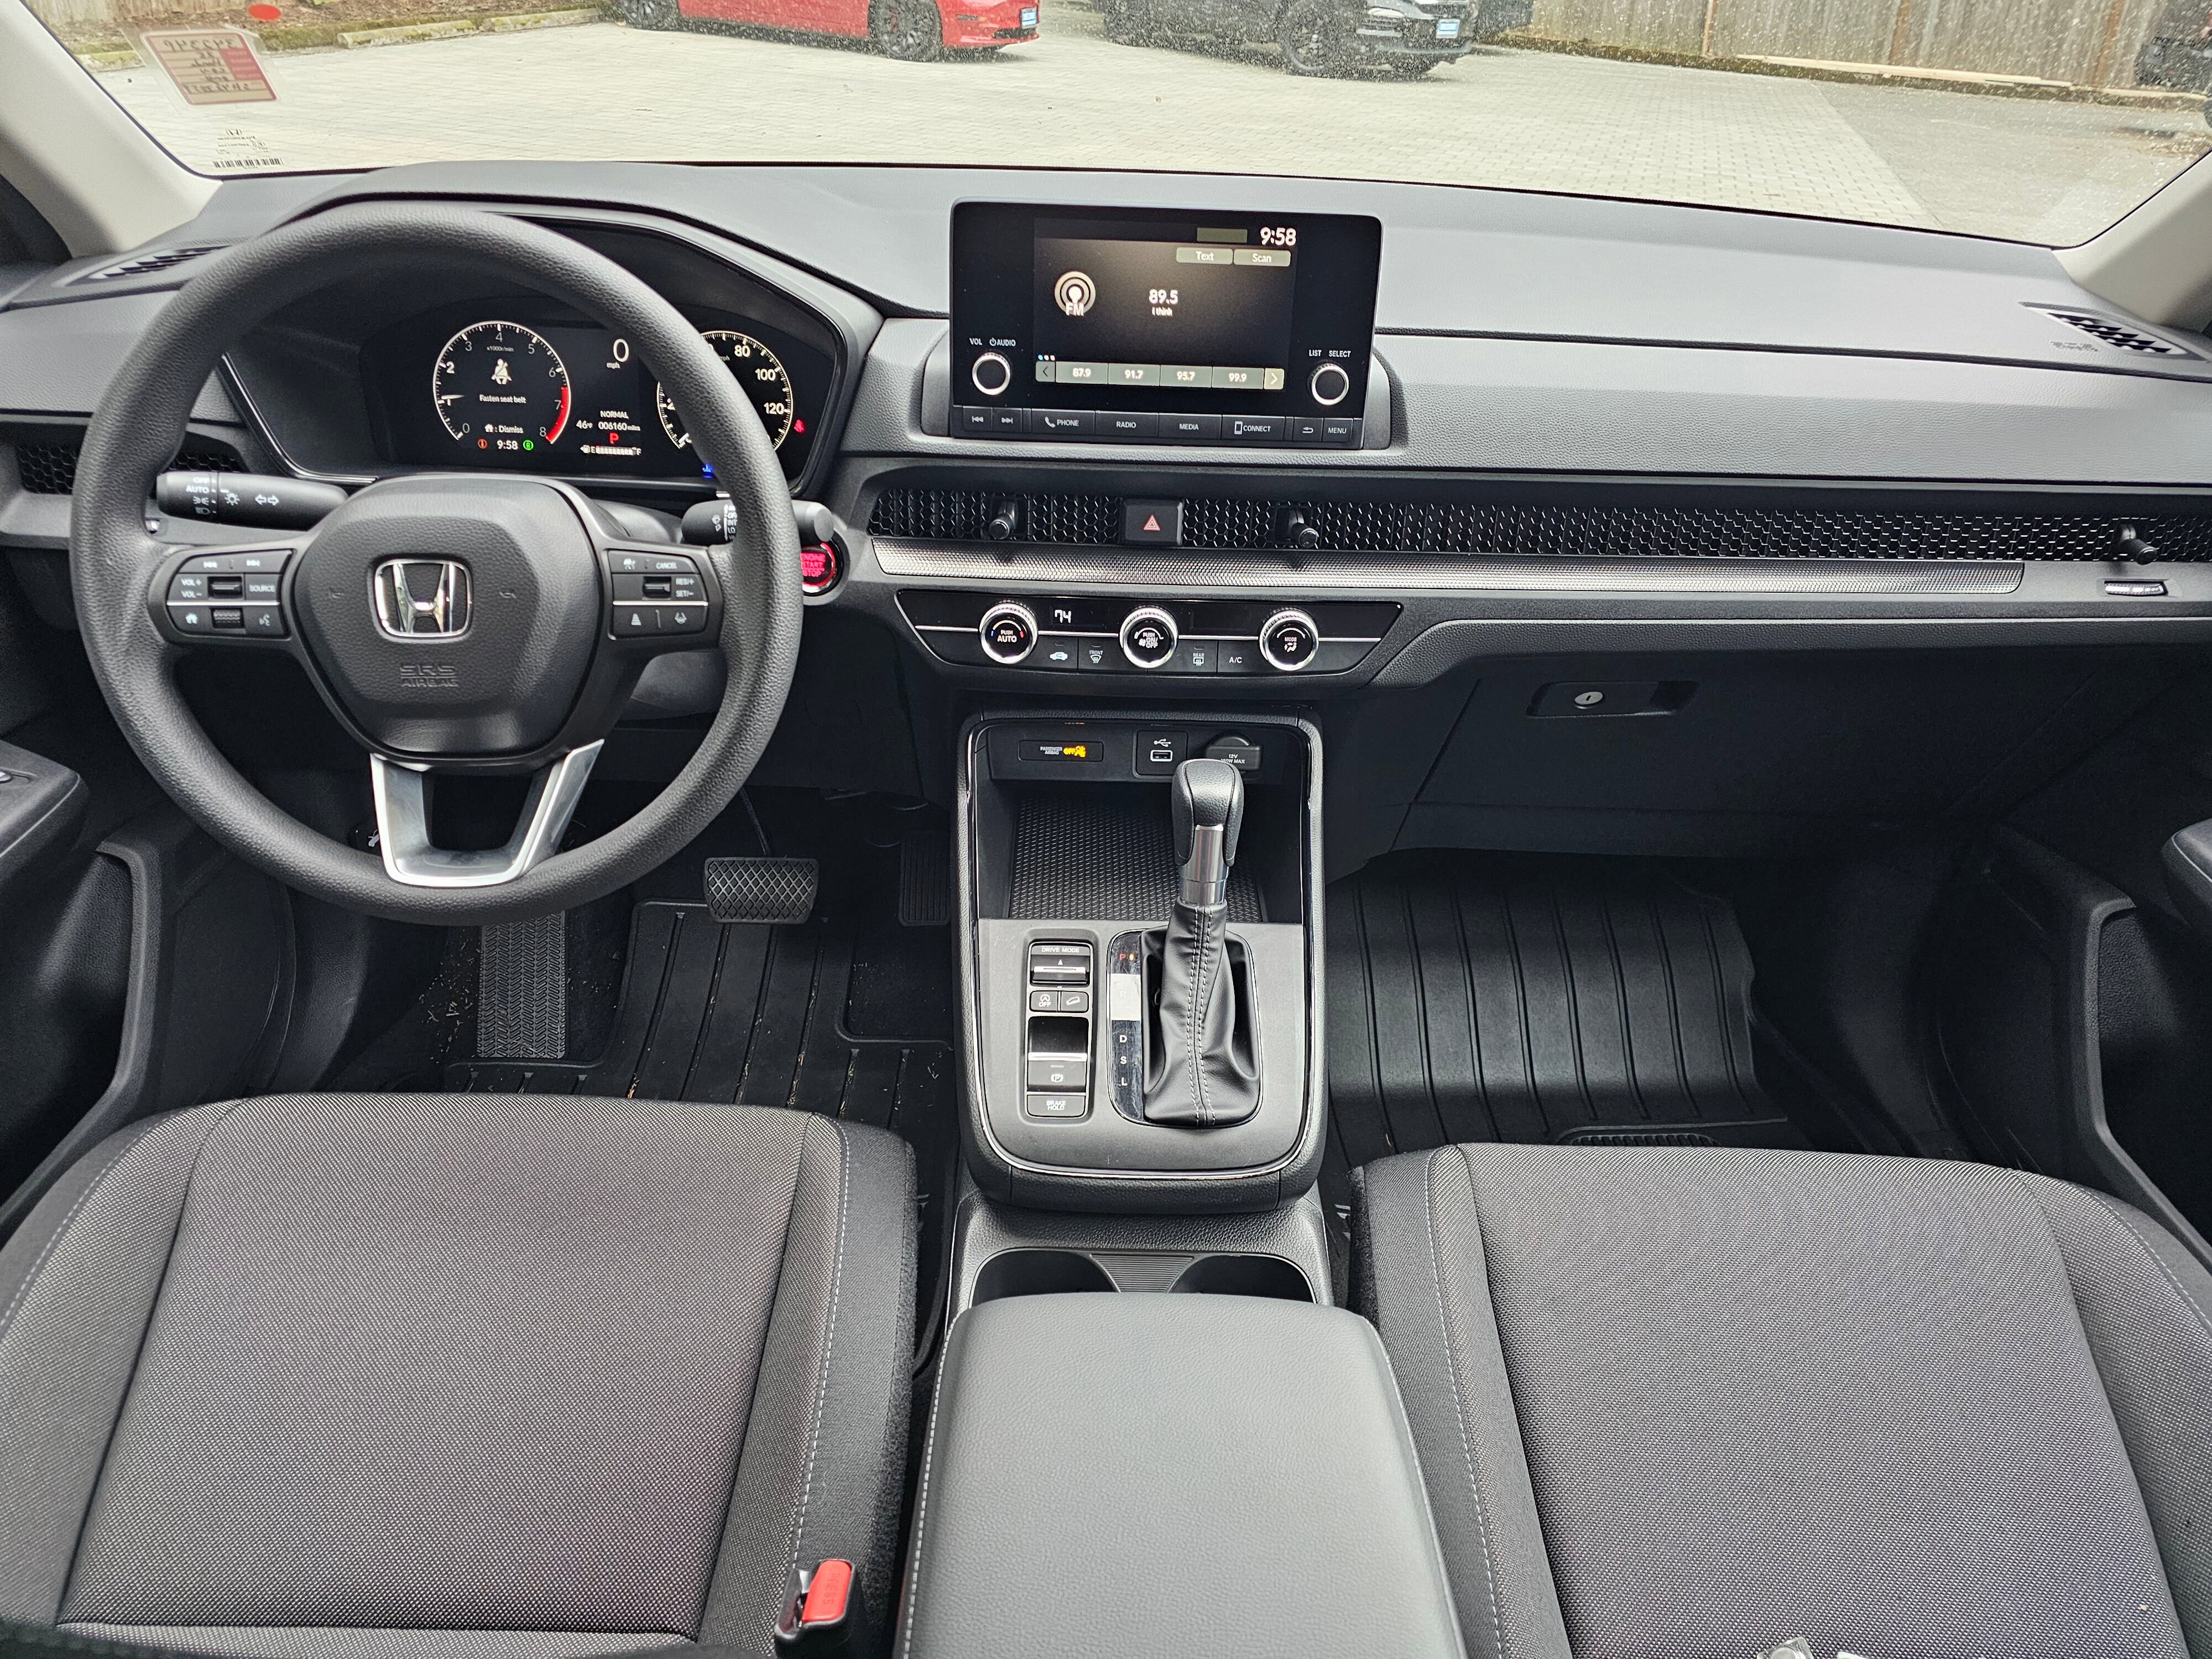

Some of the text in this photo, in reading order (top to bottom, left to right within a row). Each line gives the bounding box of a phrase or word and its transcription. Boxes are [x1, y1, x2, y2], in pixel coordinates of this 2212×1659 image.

[1260, 227, 1297, 246] 9:58
[1196, 251, 1214, 261] Text
[1253, 253, 1272, 263] Scan
[1149, 289, 1178, 305] 89.5
[1065, 303, 1084, 316] FM
[495, 332, 503, 342] 4
[465, 341, 472, 351] 3
[528, 343, 535, 354] 5
[613, 338, 629, 362] 0
[734, 345, 750, 357] 80
[1329, 350, 1352, 358] SELECT
[446, 361, 455, 374] 2
[549, 367, 556, 377] 6
[755, 369, 776, 381] 100
[1072, 368, 1091, 378] 87.9
[1124, 369, 1143, 379] 91.7
[1176, 371, 1196, 381] 95.7
[1228, 373, 1247, 383] 99.9
[479, 394, 499, 403] Fasten
[514, 395, 526, 404] belt
[555, 400, 561, 410] 7
[764, 403, 784, 415] 120
[600, 411, 629, 419] NORMAL
[462, 423, 470, 433] 0
[499, 425, 523, 434] Dismiss
[598, 422, 627, 431] 006160
[1243, 425, 1271, 433] CONNECT
[539, 427, 546, 437] 8
[609, 432, 619, 444] P
[497, 440, 518, 450] 9:58
[186, 485, 210, 494] AUTO
[249, 584, 275, 592] SOURCE
[1055, 609, 1072, 624] 74
[1120, 1056, 1127, 1064] S
[1121, 1077, 1128, 1086] L
[823, 1573, 841, 1605] PRESS
